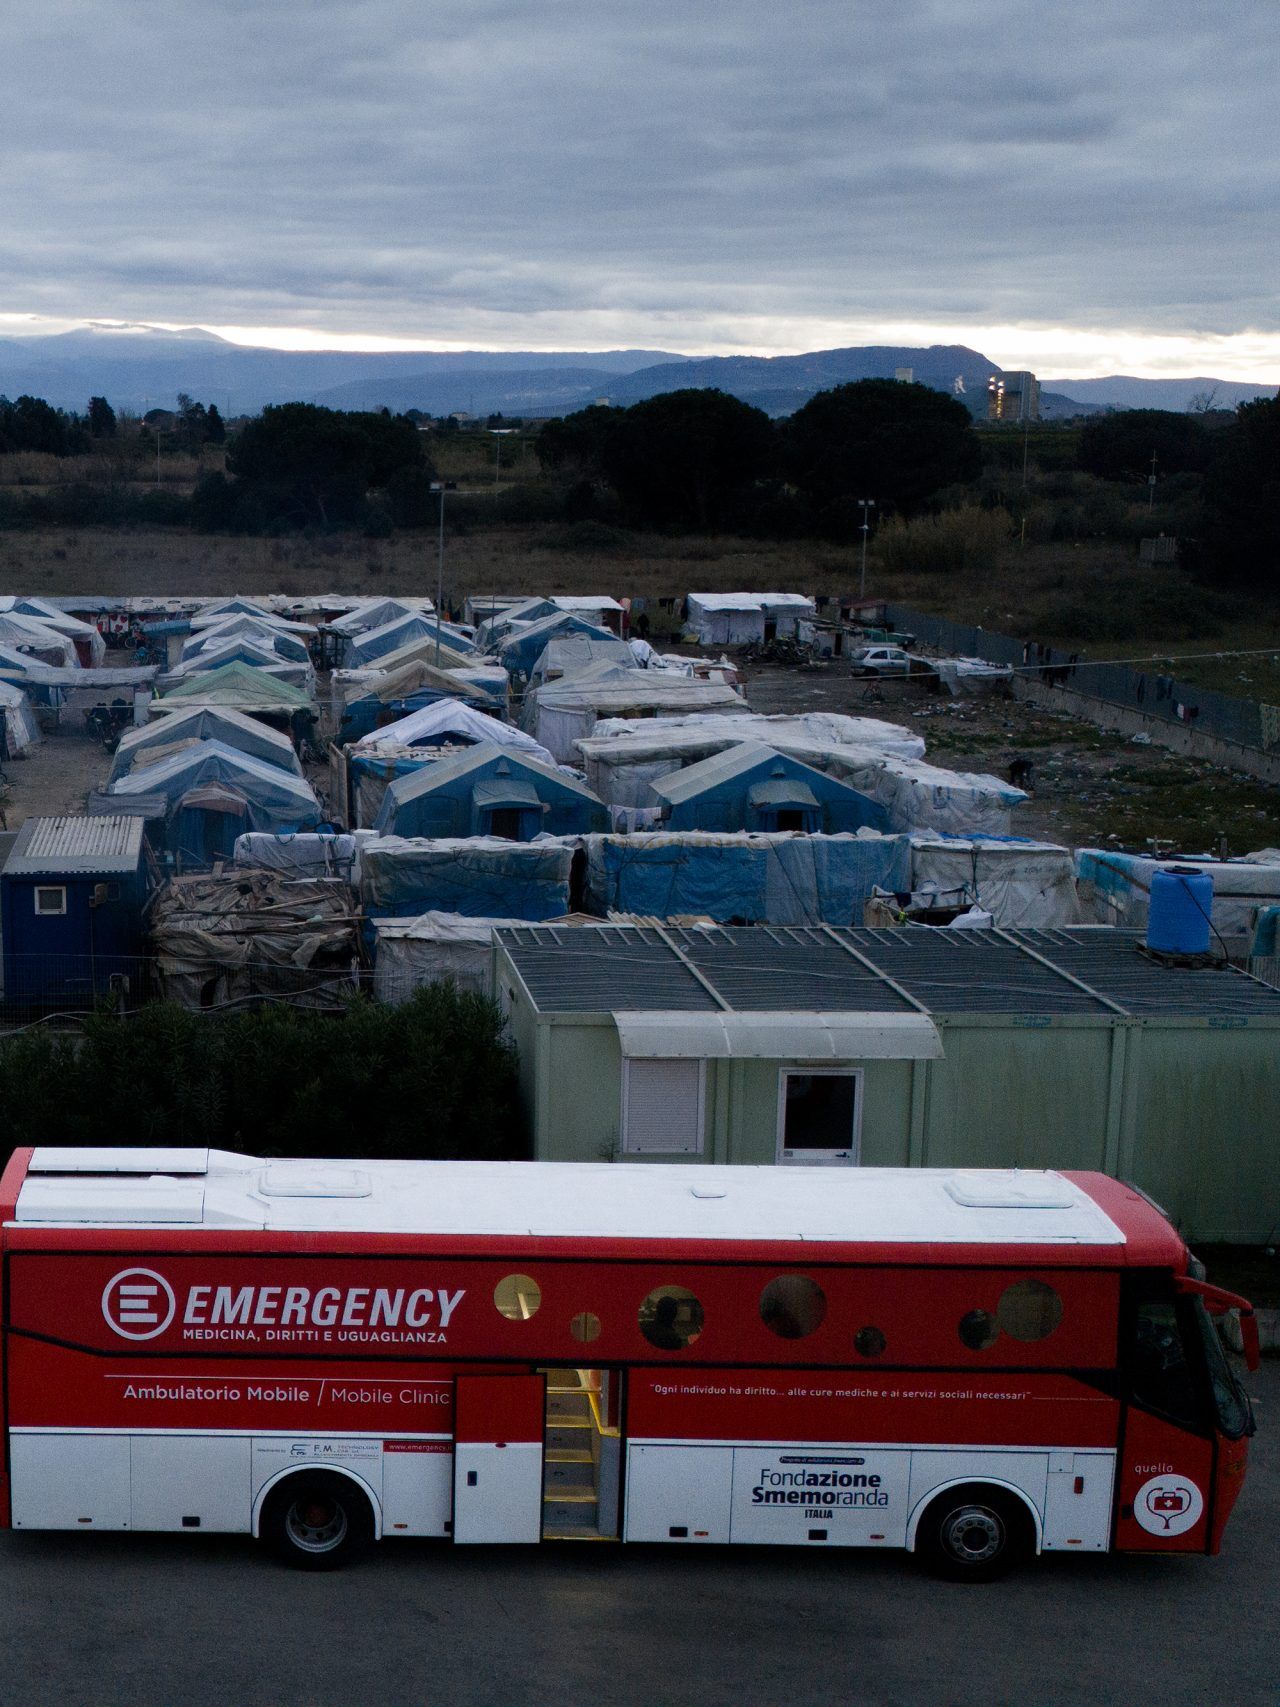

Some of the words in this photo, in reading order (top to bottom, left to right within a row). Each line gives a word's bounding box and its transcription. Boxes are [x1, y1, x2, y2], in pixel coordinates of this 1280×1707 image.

[184, 1286, 466, 1327] EMERGENCY
[184, 1330, 260, 1341] MEDICINA,
[266, 1330, 318, 1340] DIRITTI
[324, 1331, 332, 1341] E
[338, 1331, 447, 1343] UGUAGLIANZA
[124, 1385, 240, 1400] Ambulatorio
[248, 1387, 309, 1401] Mobile
[332, 1389, 392, 1403] Mobile
[400, 1390, 449, 1404] Clinic
[680, 1385, 726, 1395] individuo
[890, 1389, 899, 1398] ai
[902, 1389, 937, 1398] servizi
[939, 1390, 973, 1399] sociali
[1134, 1462, 1174, 1475] quello
[760, 1468, 881, 1487] Fondazione
[752, 1487, 889, 1505] Smemoranda
[804, 1509, 833, 1519] ITALIA
